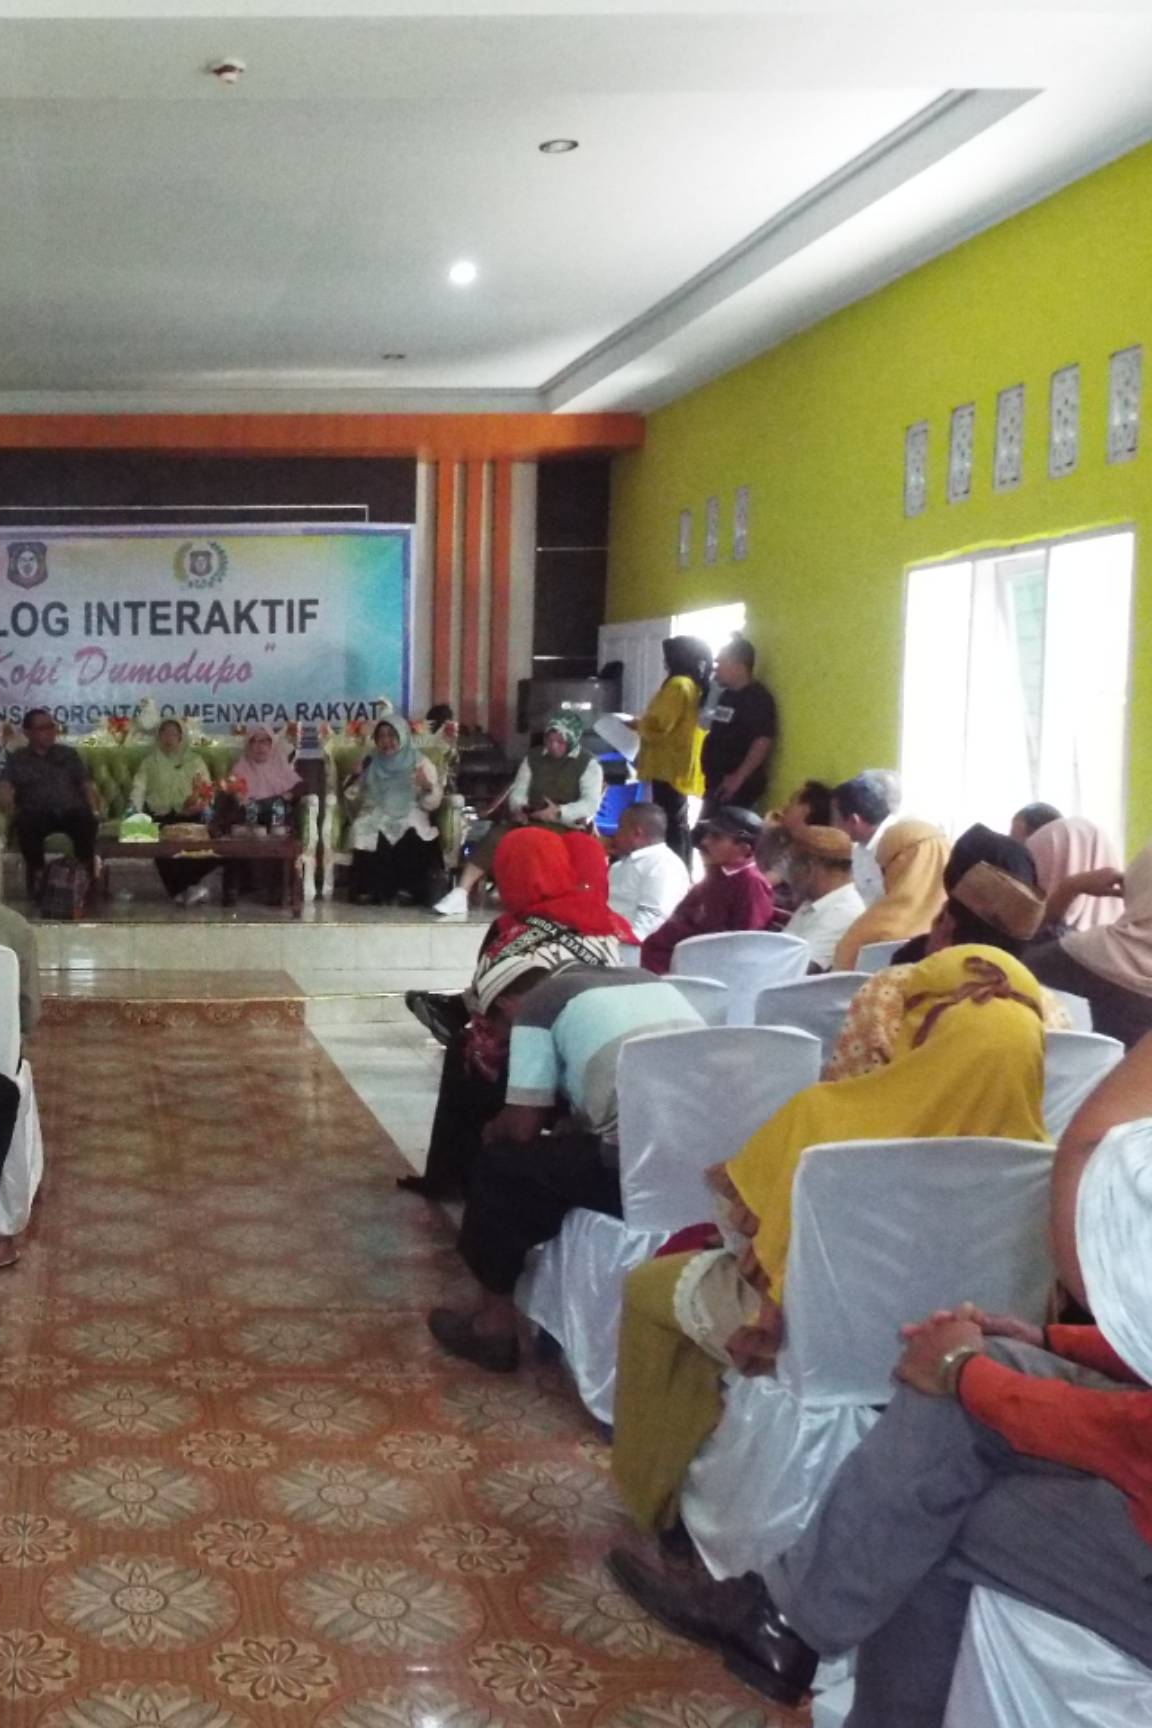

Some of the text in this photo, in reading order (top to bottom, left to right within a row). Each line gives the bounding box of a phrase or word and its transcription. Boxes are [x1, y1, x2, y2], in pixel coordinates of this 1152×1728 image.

[84, 599, 319, 636] INTERAKTIF
[42, 703, 176, 725] ORONTAO
[183, 702, 288, 723] MENYAPA
[295, 701, 380, 721] RAKYAT
